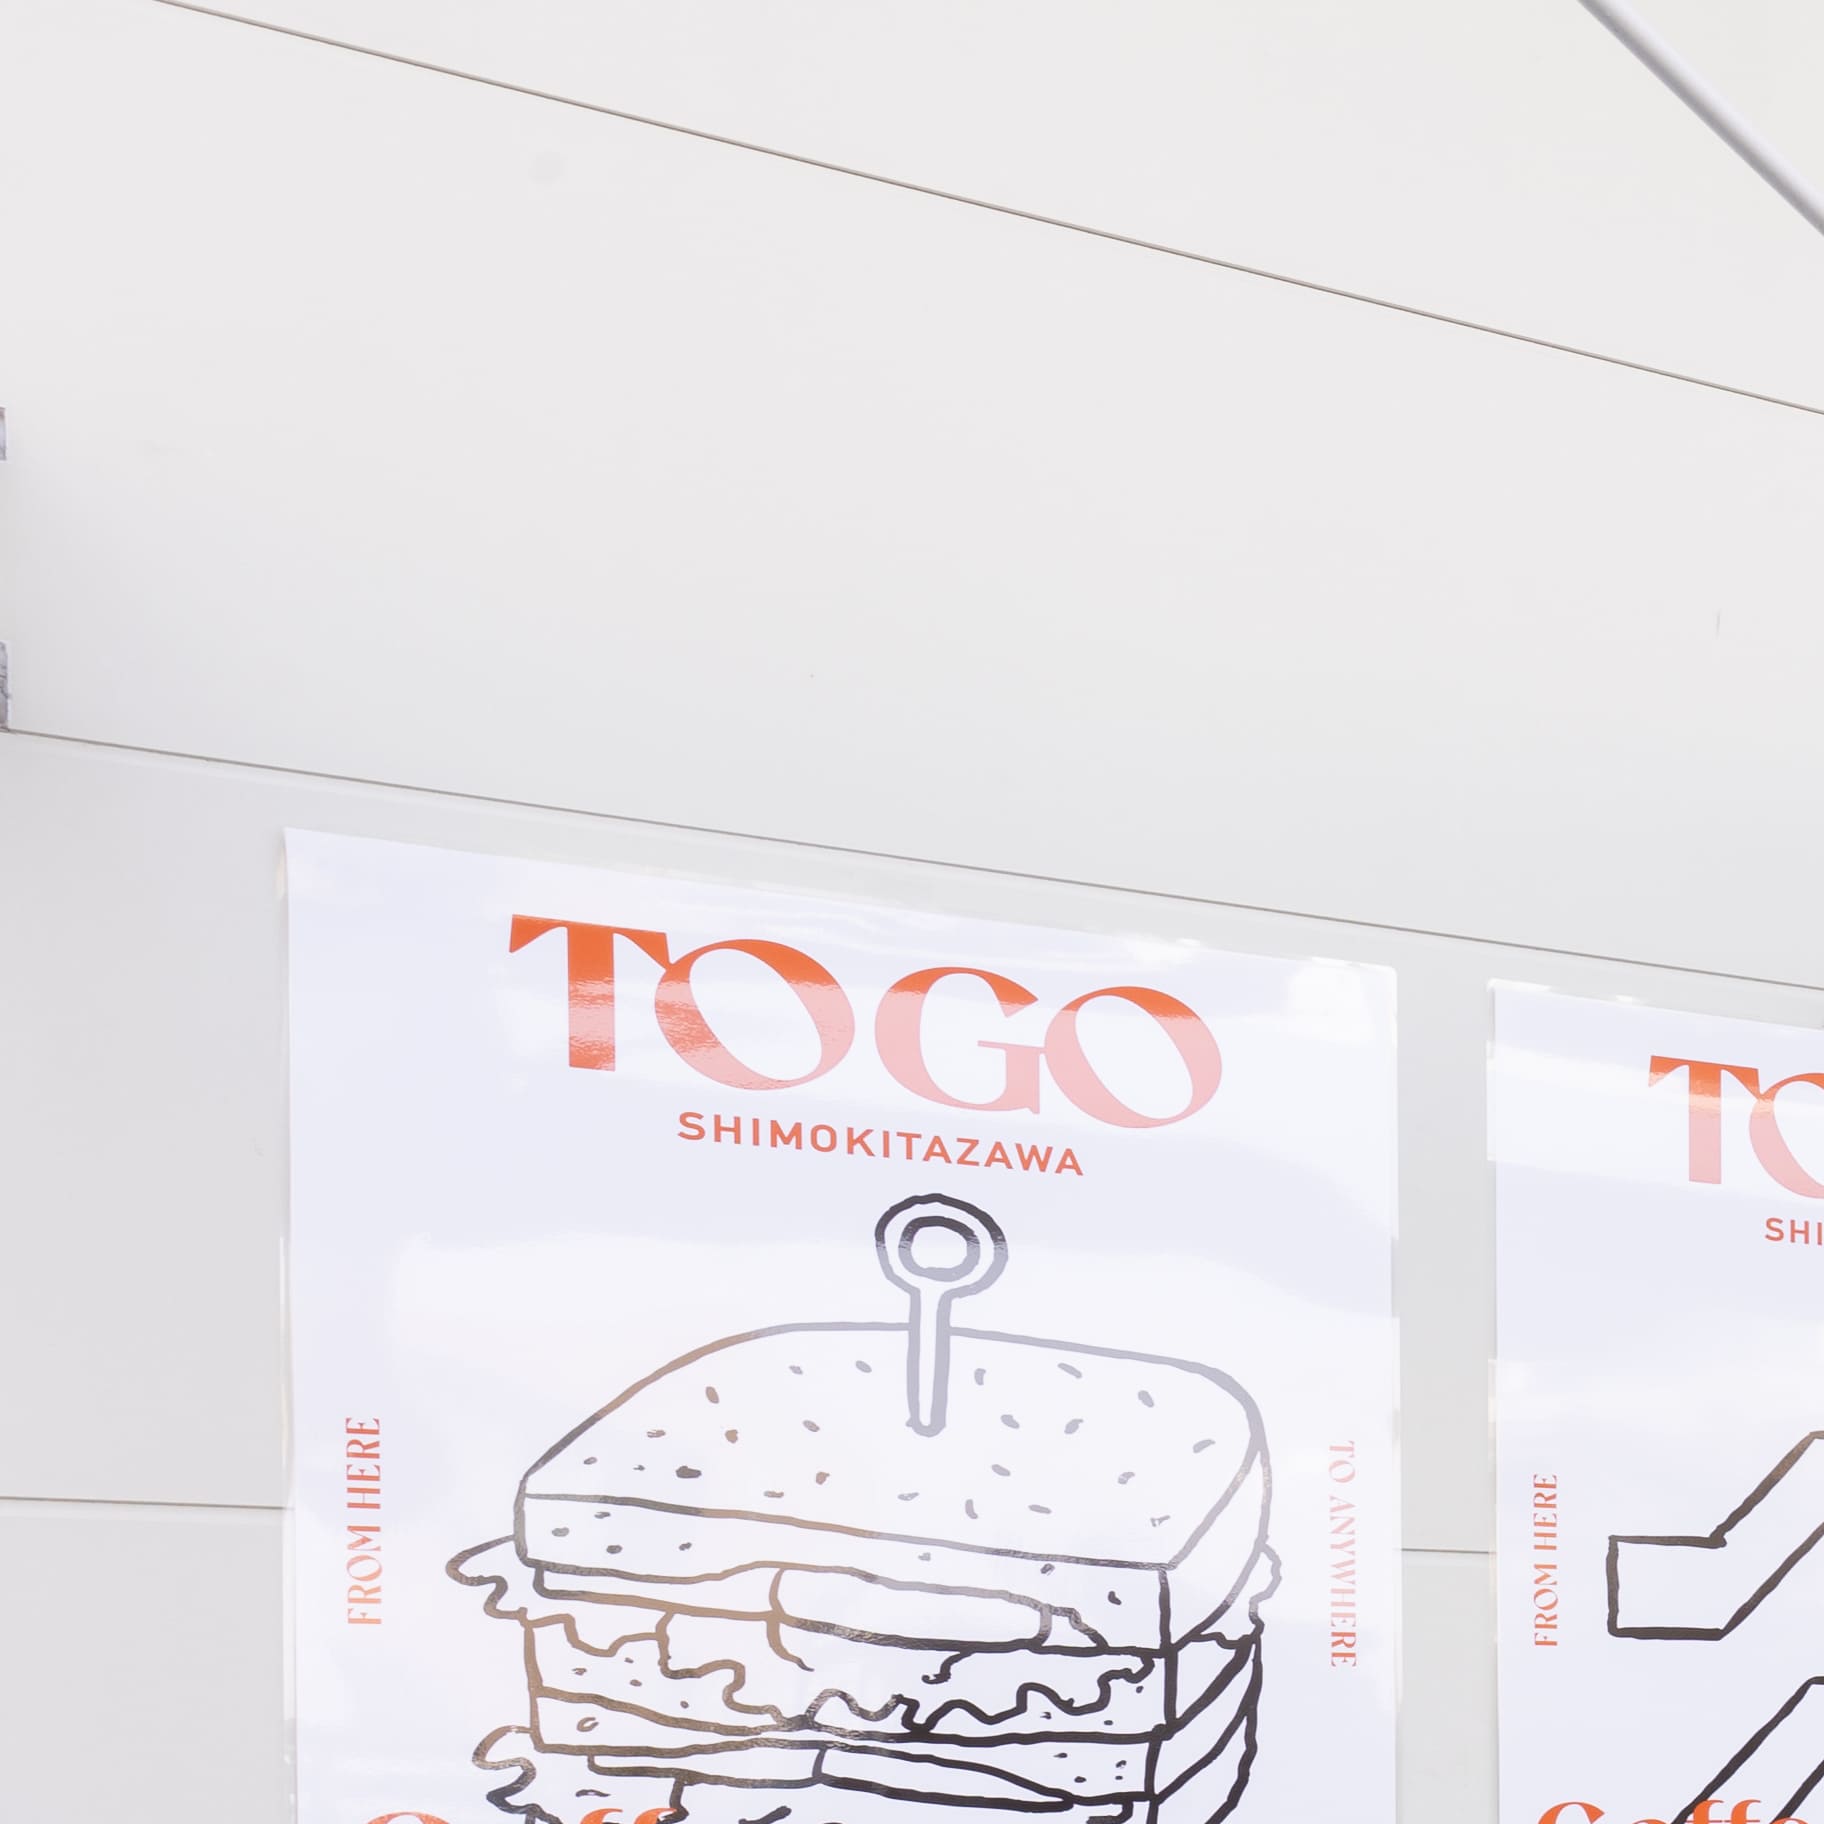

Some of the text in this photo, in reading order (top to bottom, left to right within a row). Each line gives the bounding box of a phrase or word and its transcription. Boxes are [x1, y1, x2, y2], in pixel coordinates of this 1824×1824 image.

[677, 1111, 1085, 1178] SHIMOKITAZAWA
[345, 1417, 382, 1625] FROM HERE
[1328, 1440, 1357, 1667] TO ANYWHERE
[1532, 1474, 1558, 1646] FROM HERE
